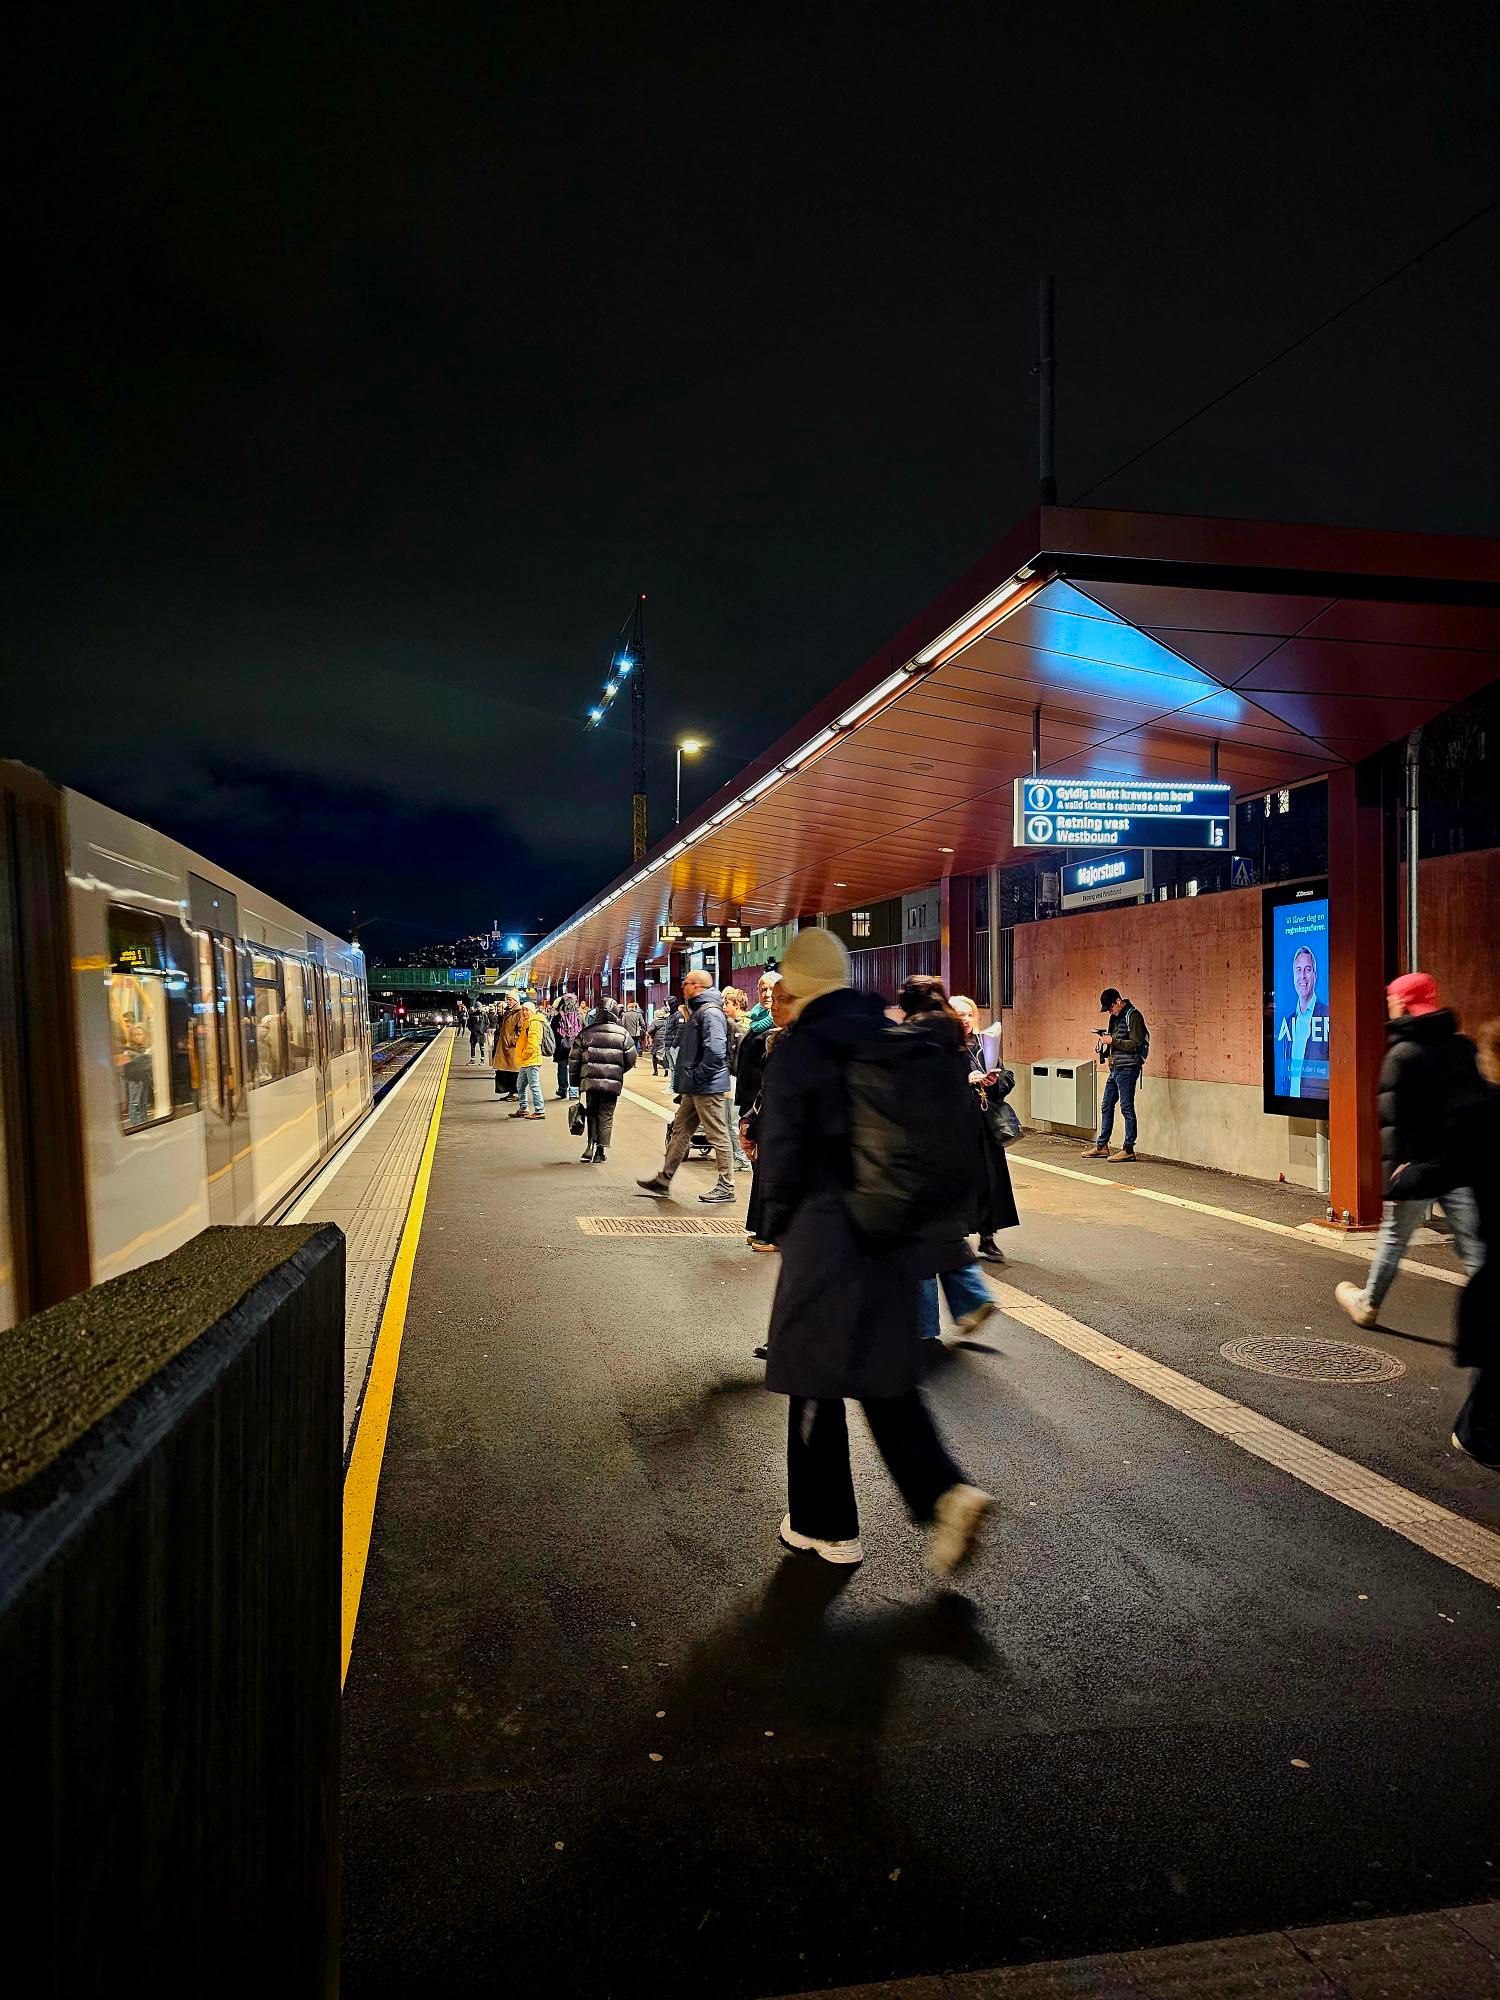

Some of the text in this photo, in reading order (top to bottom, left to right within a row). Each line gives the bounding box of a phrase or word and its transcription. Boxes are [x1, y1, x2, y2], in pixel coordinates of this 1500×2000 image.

[1056, 787, 1088, 801] Gyldig
[1090, 788, 1119, 800] billett
[1154, 792, 1170, 801] om
[1171, 791, 1194, 802] bord
[1057, 801, 1182, 813] A valid ticket is required on board
[1057, 815, 1130, 832] Retning vest
[1056, 830, 1118, 844] Westbound
[1077, 861, 1126, 887] Majorstuen
[1306, 913, 1317, 923] deg
